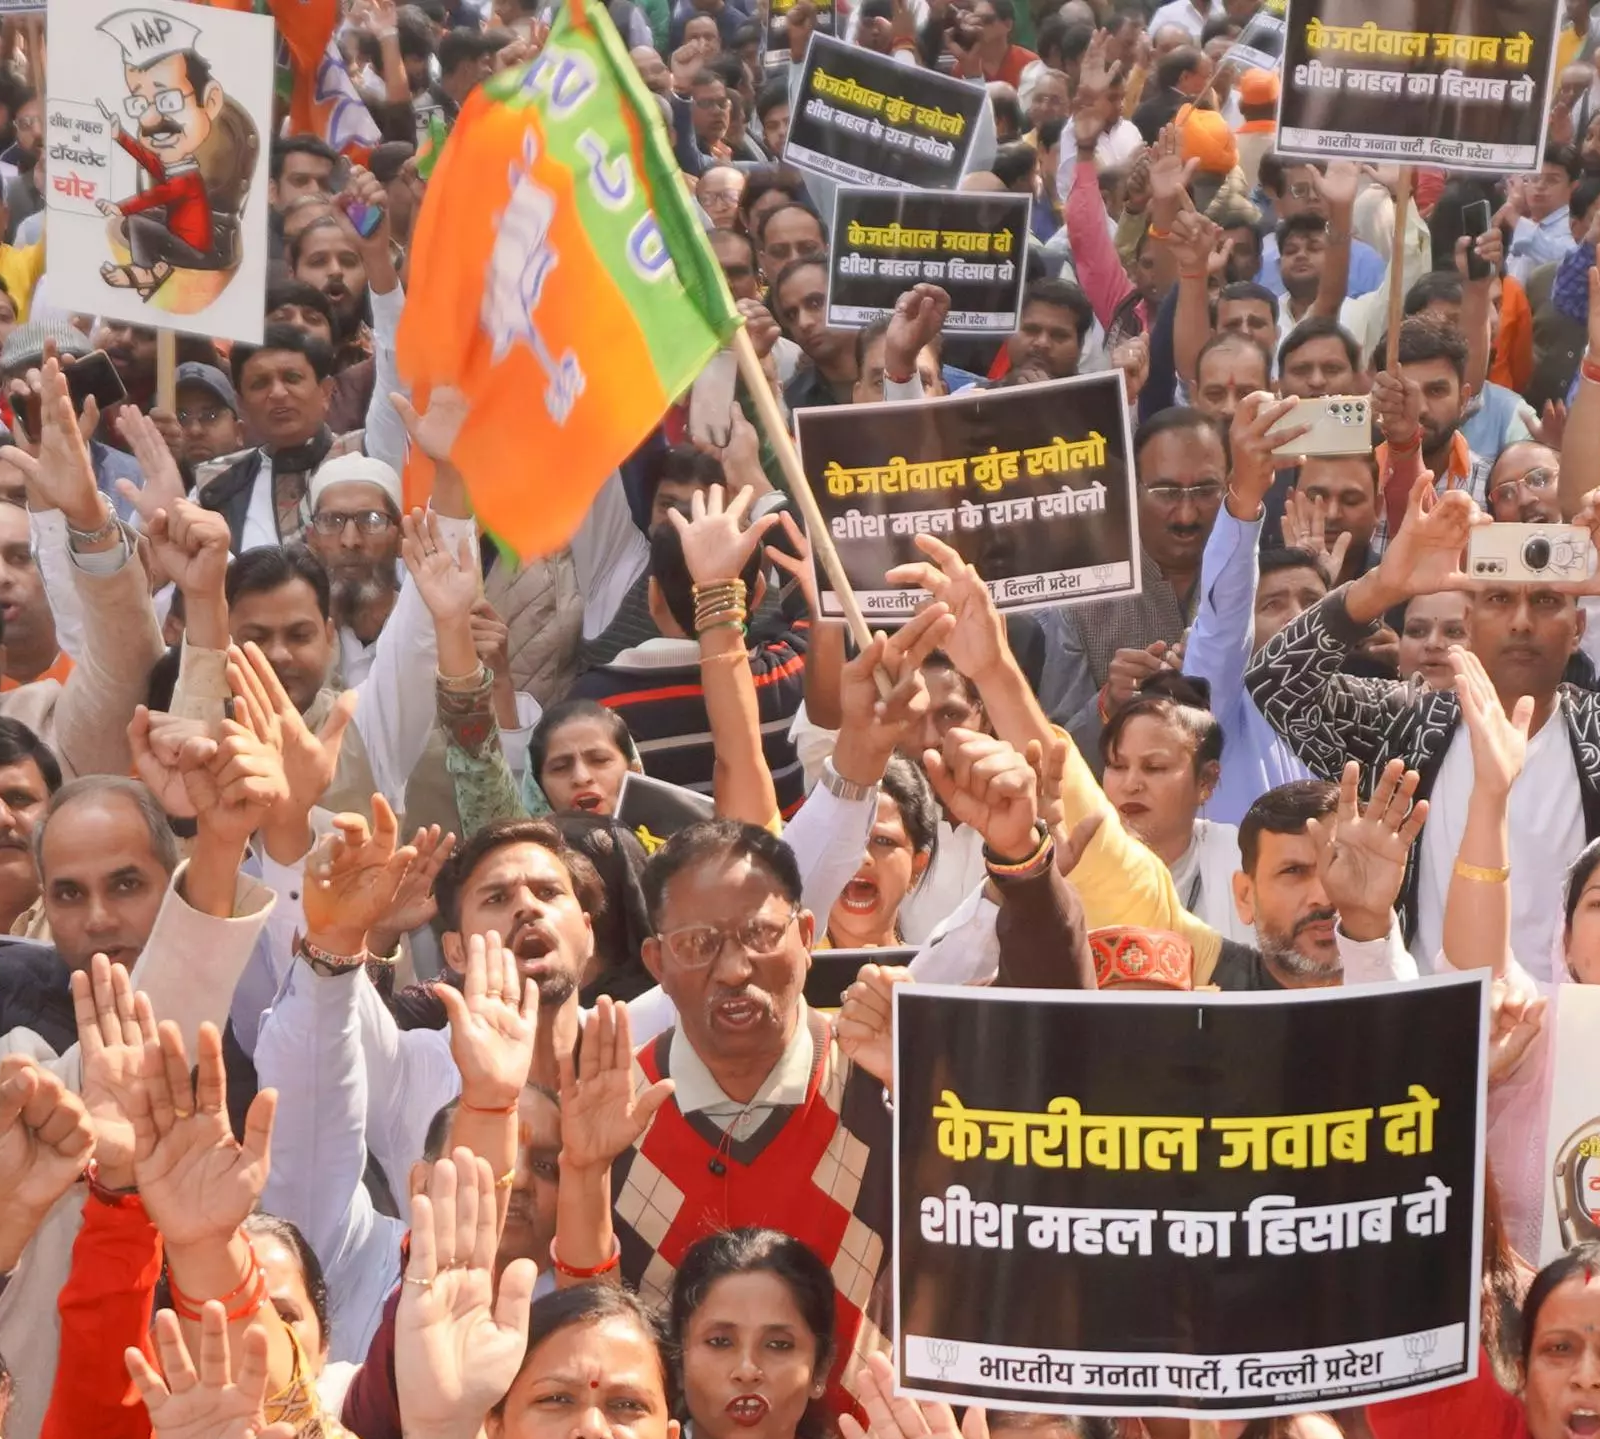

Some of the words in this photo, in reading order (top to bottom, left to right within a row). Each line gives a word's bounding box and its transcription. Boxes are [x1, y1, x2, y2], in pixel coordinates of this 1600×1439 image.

[131, 17, 173, 49] AAP
[1306, 16, 1430, 57] केजरीवाल
[1432, 33, 1501, 62] जवाब
[1504, 30, 1534, 64] दो
[813, 67, 885, 111] केजरीवाल
[885, 96, 914, 123] मुंह
[916, 105, 966, 136] खोलो
[1294, 59, 1344, 89] शीश
[1346, 68, 1404, 93] महल
[1407, 73, 1439, 95] का
[1440, 68, 1509, 100] हिसाब
[1509, 74, 1536, 102] दो
[805, 98, 833, 121] शीश
[834, 109, 869, 133] महल
[869, 120, 885, 137] के
[884, 128, 913, 148] राज
[913, 135, 956, 161] खोलो
[1317, 133, 1361, 149] भारतीय
[1363, 138, 1397, 152] जनता
[1430, 140, 1464, 157] दिल्ली
[1466, 144, 1493, 160] प्रदेश
[50, 143, 107, 168] टॉयलेट
[52, 171, 97, 201] चोर
[848, 219, 939, 249] केजरीवाल
[941, 230, 991, 252] जवाब
[993, 227, 1014, 253] दो
[840, 252, 877, 275] शीश
[878, 258, 920, 277] महल
[922, 260, 946, 279] का
[948, 257, 997, 280] हिसाब
[998, 259, 1015, 281] दो
[969, 314, 988, 325] प्रदेश
[824, 455, 967, 496] केजरीवाल
[971, 446, 1021, 492] मुंह
[1024, 430, 1107, 474] खोलो
[832, 508, 889, 538] शीश
[890, 507, 956, 536] महल
[958, 499, 989, 529] के
[989, 497, 1035, 524] राज
[1037, 480, 1107, 518] खोलो
[1003, 576, 1046, 599] दिल्ली
[1047, 572, 1082, 592] प्रदेश
[932, 1089, 1204, 1172] केजरीवाल
[1210, 1106, 1374, 1171] जवाब
[1379, 1083, 1440, 1157] दो
[920, 1184, 1019, 1250] शीश
[1023, 1203, 1158, 1256] महल
[1163, 1209, 1237, 1257] का
[1243, 1194, 1398, 1257] हिसाब
[1401, 1175, 1452, 1237] दो
[979, 1354, 1074, 1386] भारतीय
[1081, 1361, 1158, 1388] जनता
[1166, 1360, 1231, 1396] पार्टी,
[1236, 1354, 1319, 1391] दिल्ली
[1324, 1348, 1384, 1383] प्रदेश
